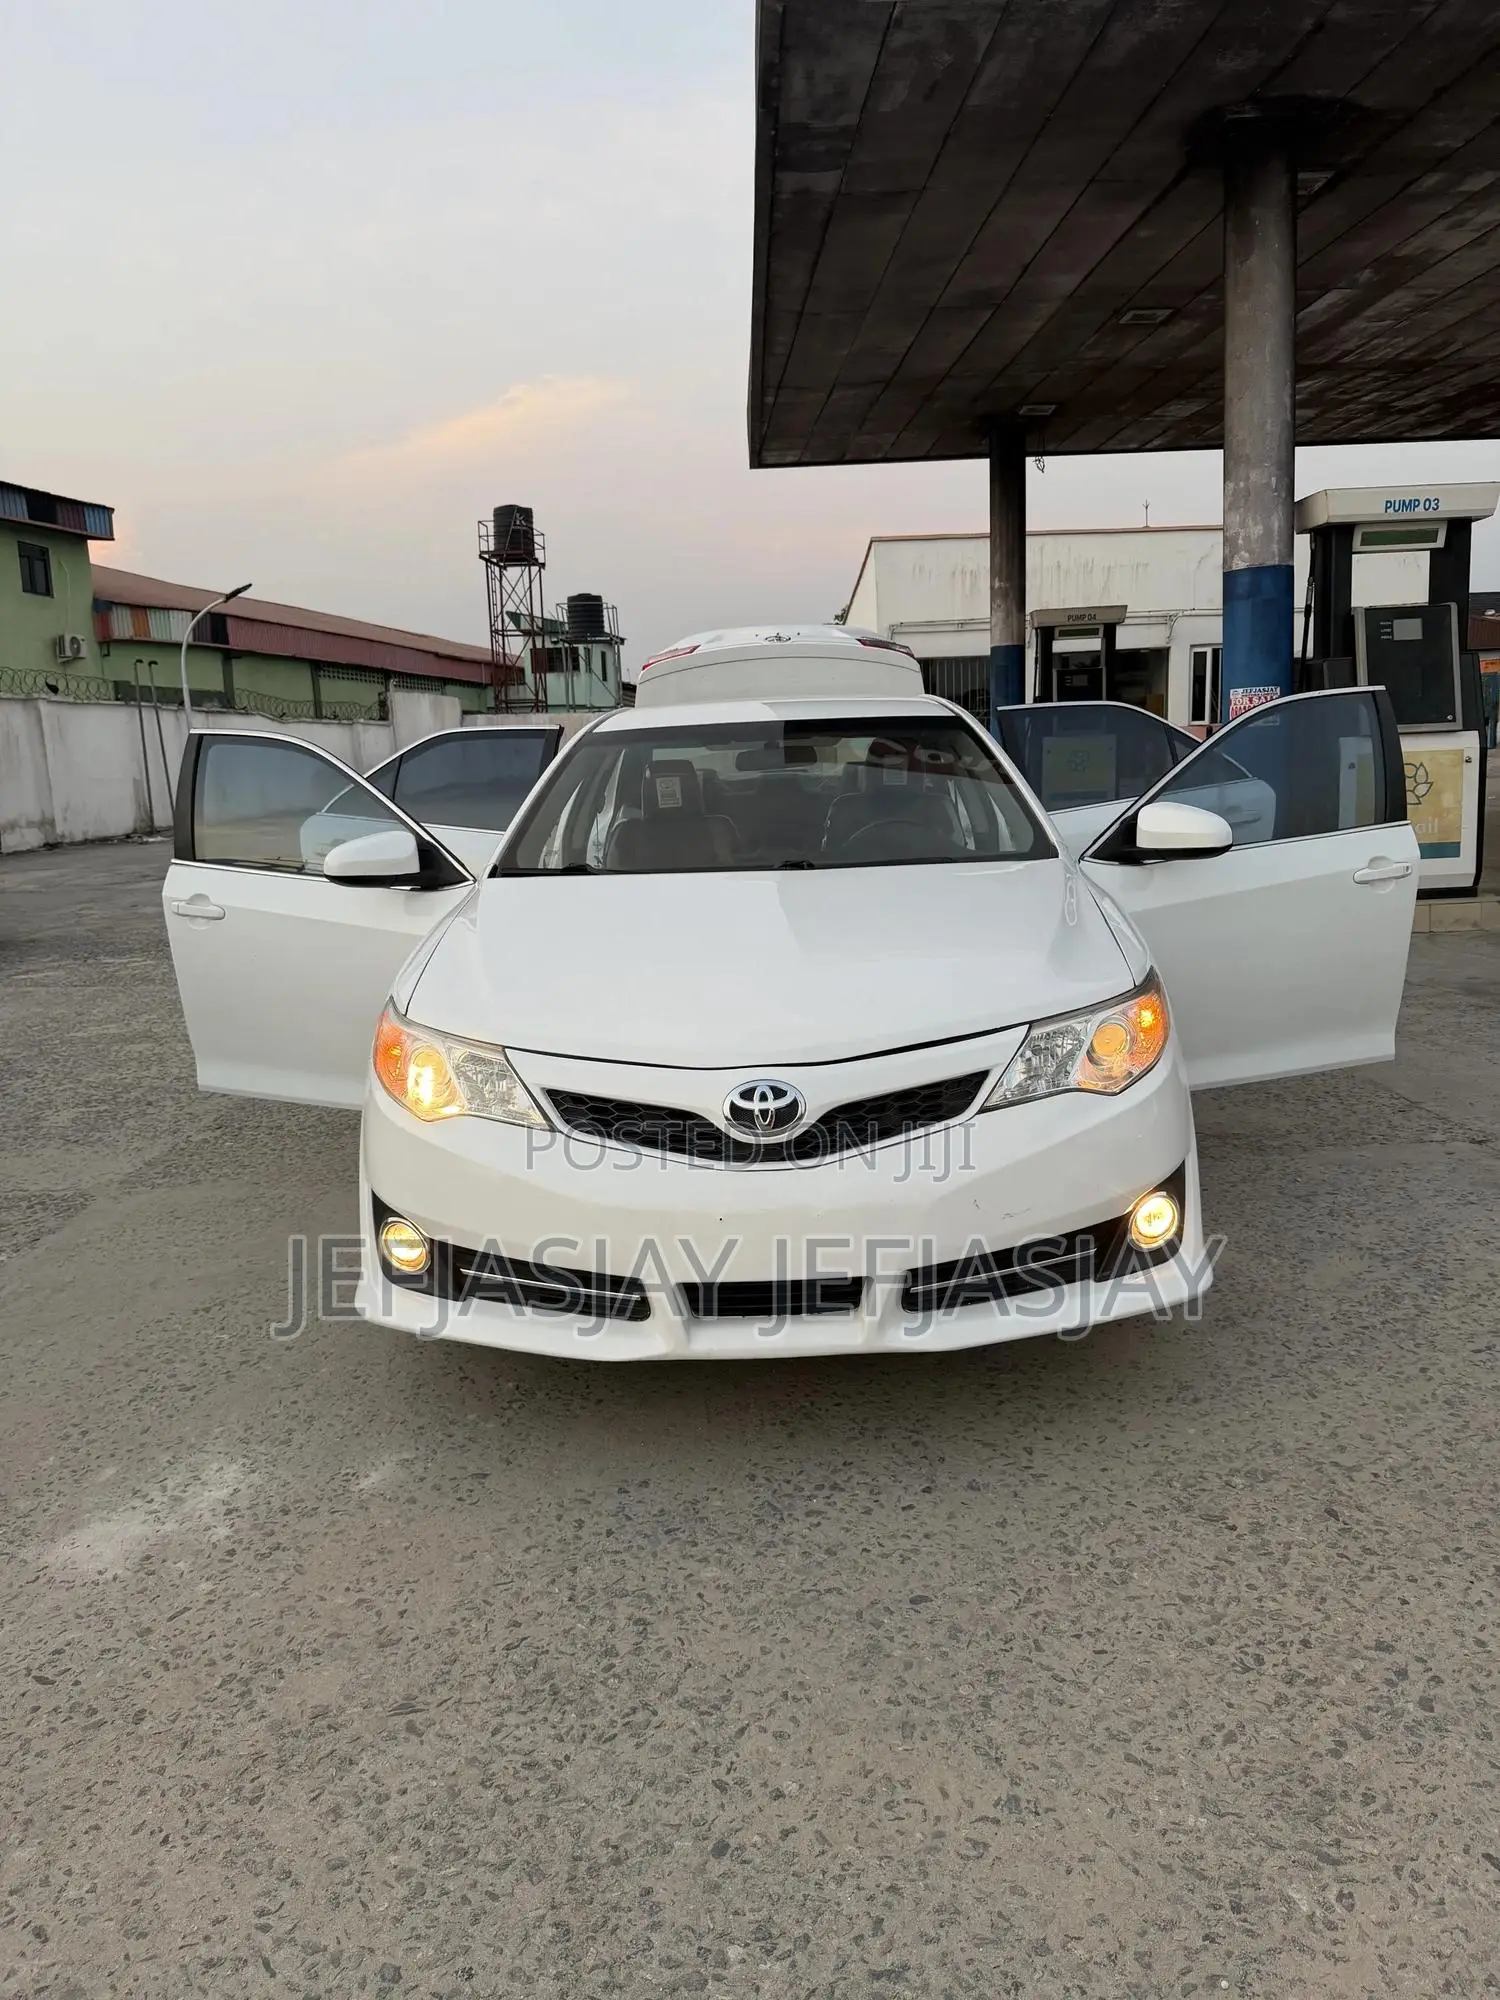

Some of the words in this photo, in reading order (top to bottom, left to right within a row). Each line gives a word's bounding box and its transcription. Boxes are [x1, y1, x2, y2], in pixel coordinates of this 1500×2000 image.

[1384, 498, 1420, 513] PUMP
[1423, 497, 1440, 511] 03
[1067, 613, 1086, 622] PUMP
[1087, 612, 1097, 621] 04
[1231, 696, 1249, 705] FOR
